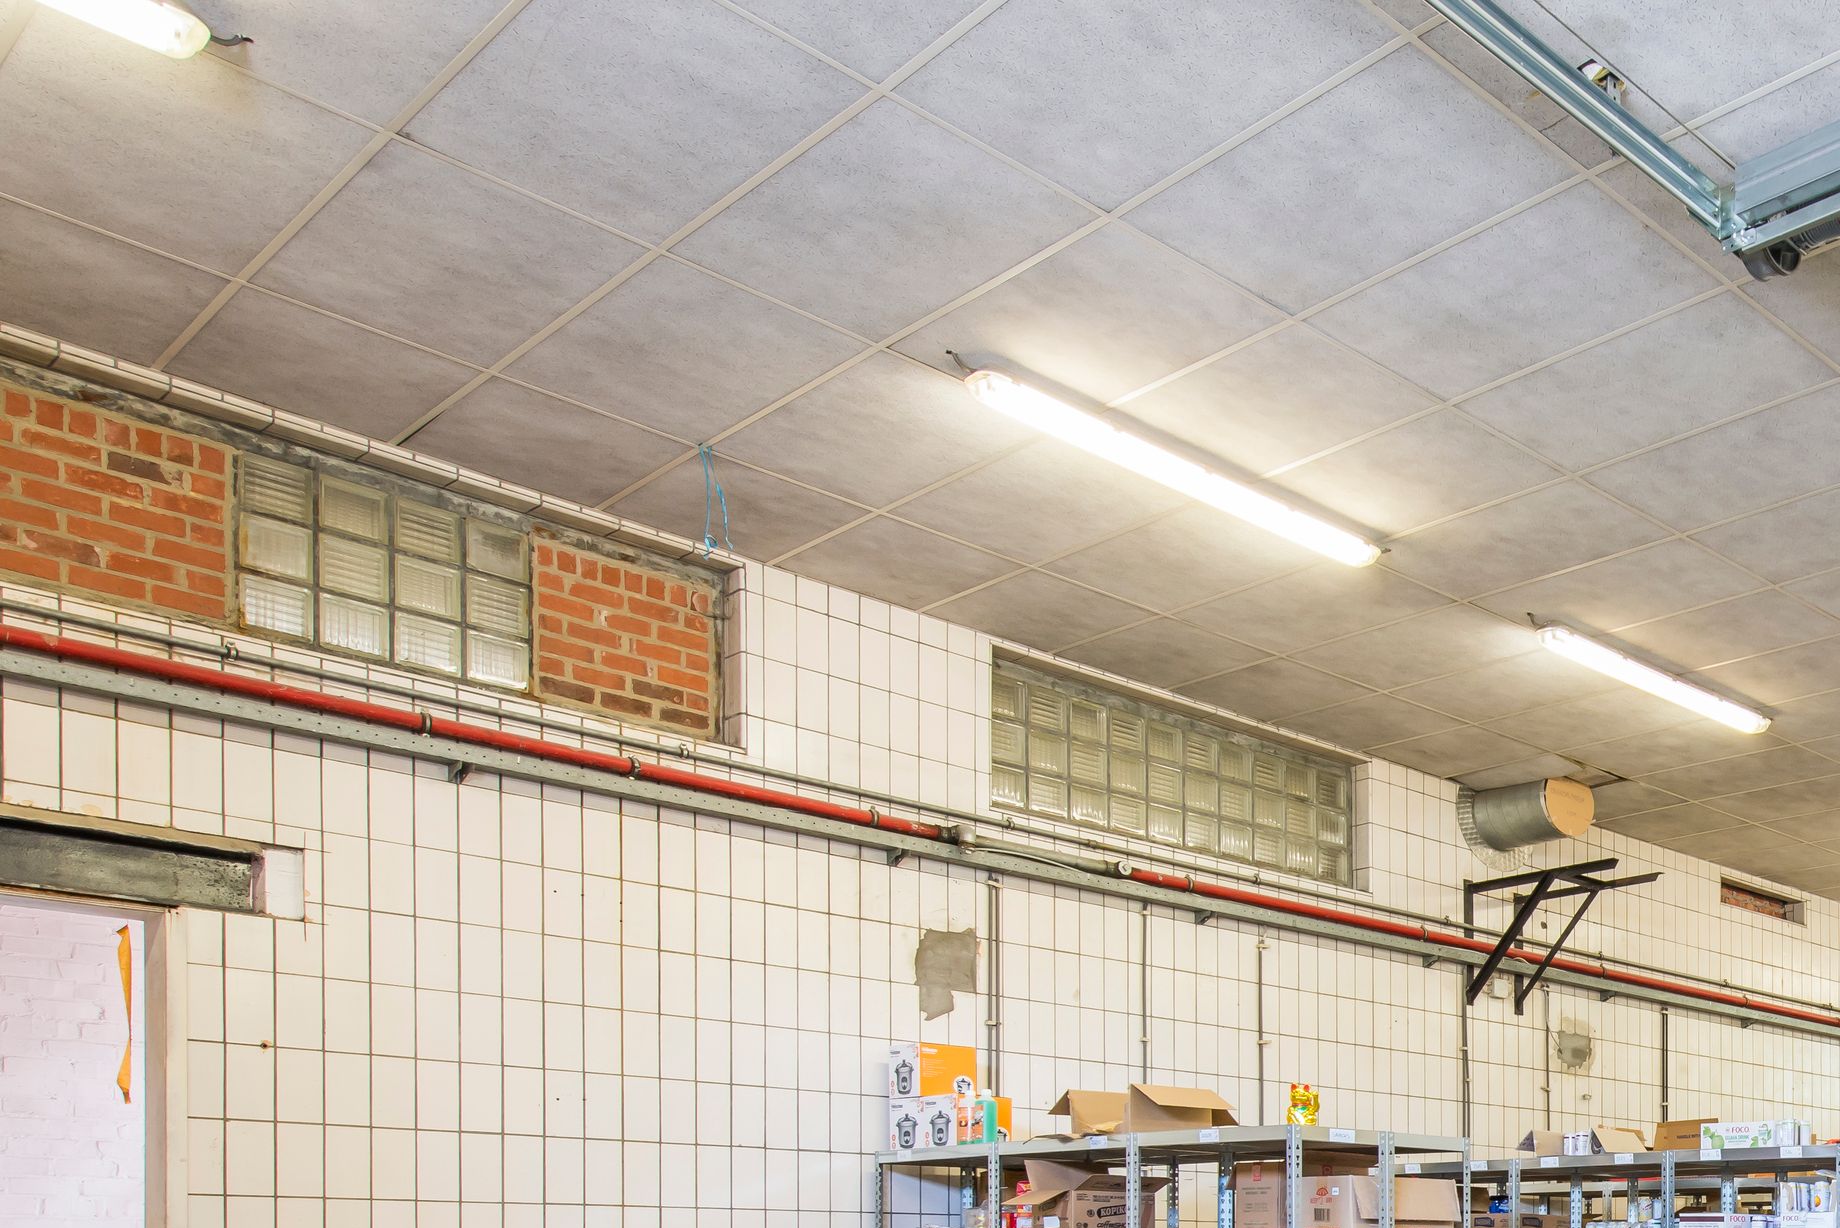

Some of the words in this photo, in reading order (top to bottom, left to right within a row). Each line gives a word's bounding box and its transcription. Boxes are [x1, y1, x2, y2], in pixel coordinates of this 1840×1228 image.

[1731, 1126, 1749, 1134] FOCO
[1100, 1206, 1126, 1217] KOPIK
[1729, 1215, 1746, 1223] FOCO
